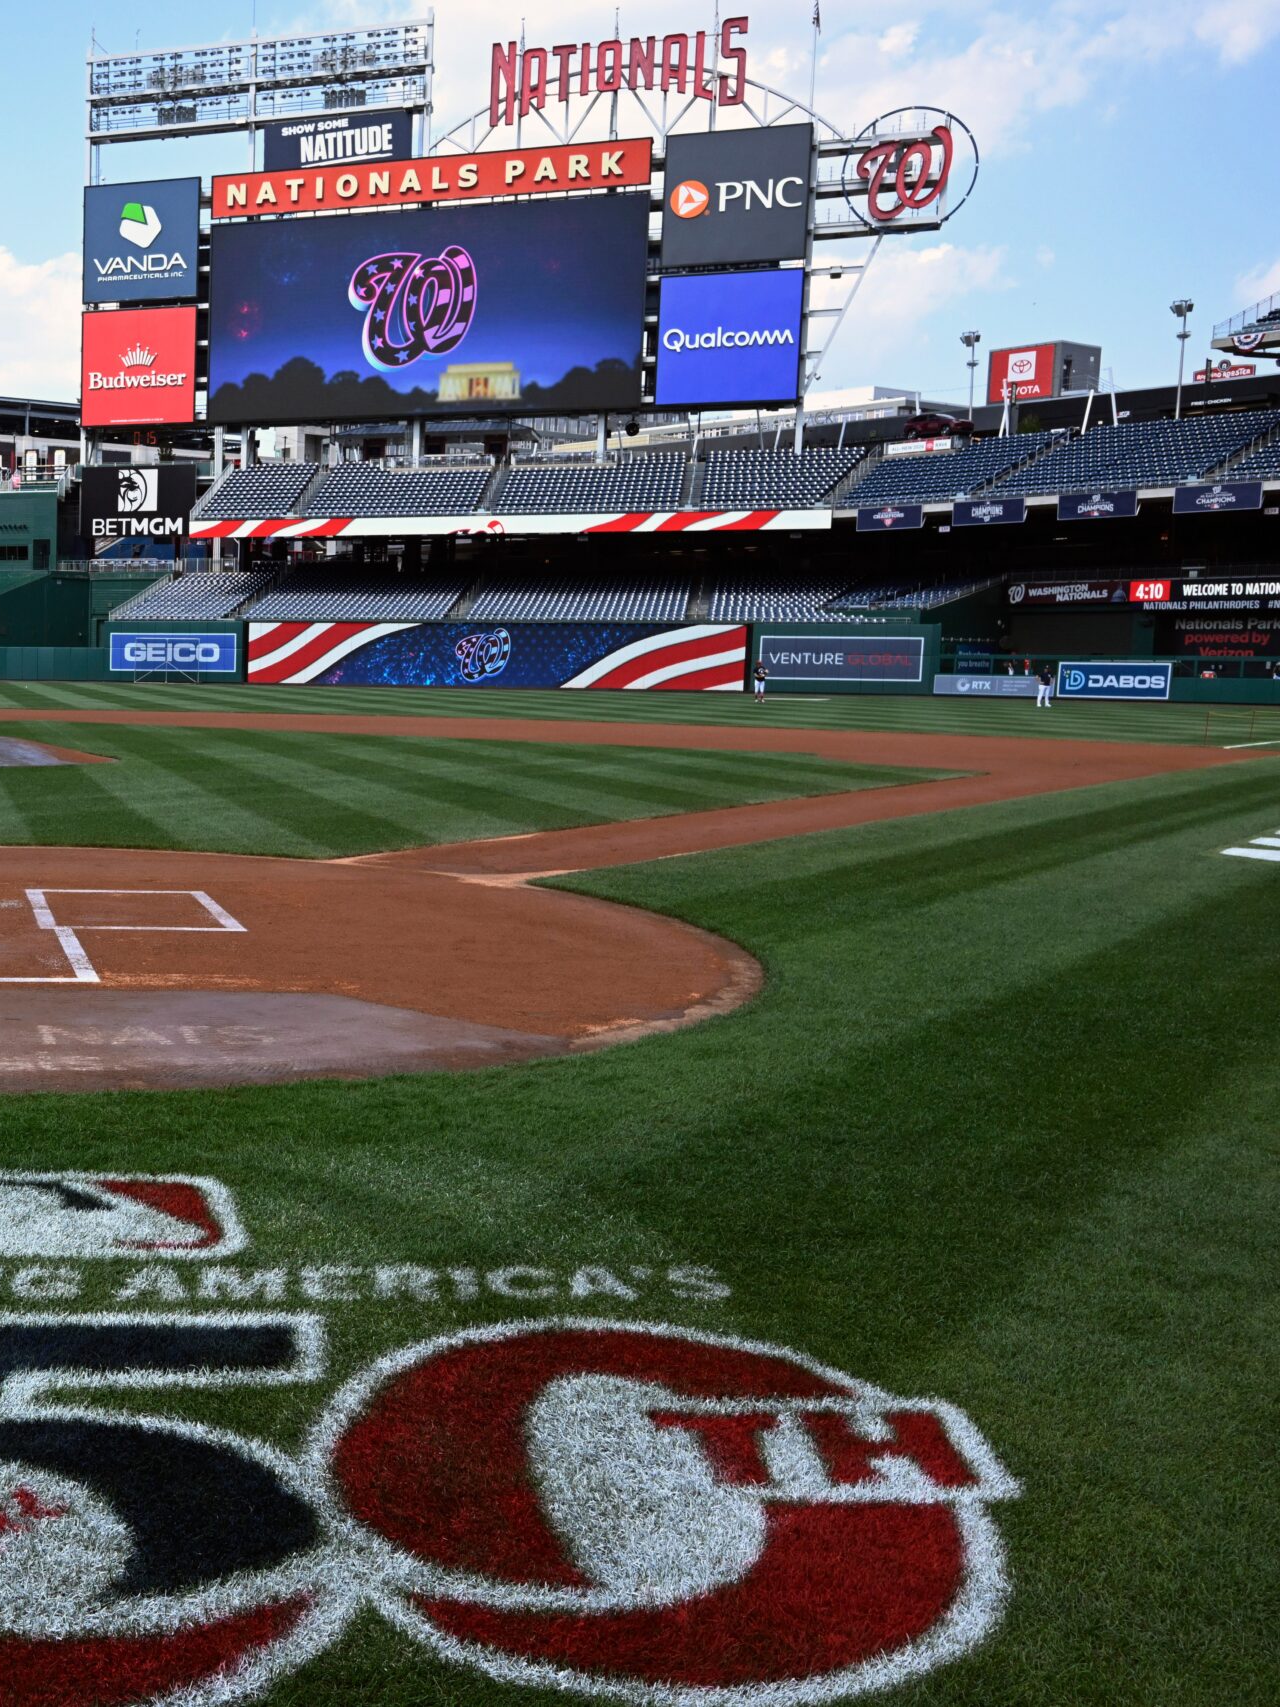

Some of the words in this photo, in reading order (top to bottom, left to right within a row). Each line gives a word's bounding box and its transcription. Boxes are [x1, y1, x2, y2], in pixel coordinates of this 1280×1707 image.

[490, 16, 748, 127] NATIONALS
[281, 123, 315, 137] SHOW
[317, 118, 349, 132] SOME
[300, 124, 393, 163] NATITUDE
[226, 163, 479, 207] NATIONALS
[505, 150, 625, 184] PARK
[715, 177, 804, 212] PNC
[93, 252, 188, 275] VANDA
[97, 272, 169, 282] PHARMACEUTICALS
[663, 327, 794, 352] Qualcomm
[88, 370, 187, 390] Budweiser
[1077, 503, 1114, 513] CHAMPIONS
[1195, 496, 1236, 505] CHAMPIONS
[971, 505, 1004, 517] CHAMPIONS
[92, 517, 183, 536] BETMGM
[1028, 584, 1089, 597] WASHINGTON
[1055, 589, 1108, 601] NATIONALS
[1135, 583, 1163, 599] 4:10
[1183, 583, 1228, 596] WELCOME
[1231, 583, 1243, 595] TO
[1143, 601, 1187, 610] NATIONALS
[1189, 600, 1260, 610] PHILANTHROPIES
[1175, 618, 1243, 630] Nationals
[1184, 632, 1249, 645] powered
[1251, 631, 1270, 646] by
[123, 642, 220, 663] GEICO
[770, 652, 844, 665] VENTURE
[847, 653, 912, 666] GLOBAL
[1200, 647, 1254, 657] Verizon
[971, 680, 991, 690] RTX
[1088, 674, 1166, 689] DABOS
[116, 1262, 733, 1303] AMERICA'S
